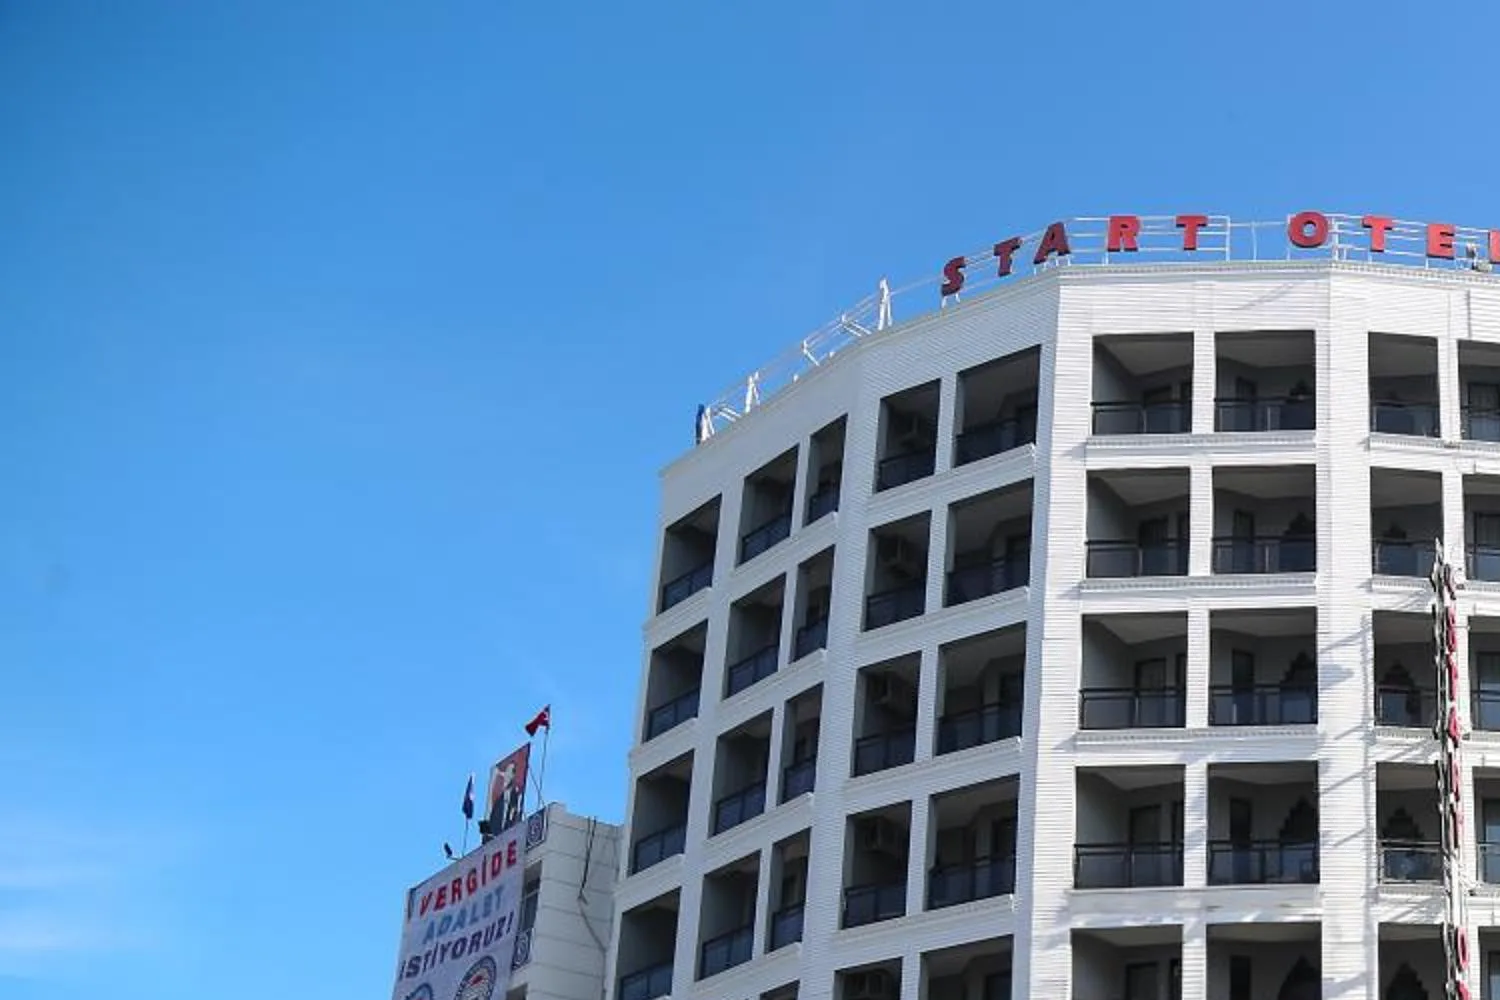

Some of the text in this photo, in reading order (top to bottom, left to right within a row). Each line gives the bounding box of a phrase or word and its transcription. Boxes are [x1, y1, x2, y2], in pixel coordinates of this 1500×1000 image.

[941, 214, 1208, 296] START
[420, 840, 517, 916] VERGİDE
[423, 885, 504, 944] ADALET
[399, 910, 514, 982] İSTİYORUZ!
